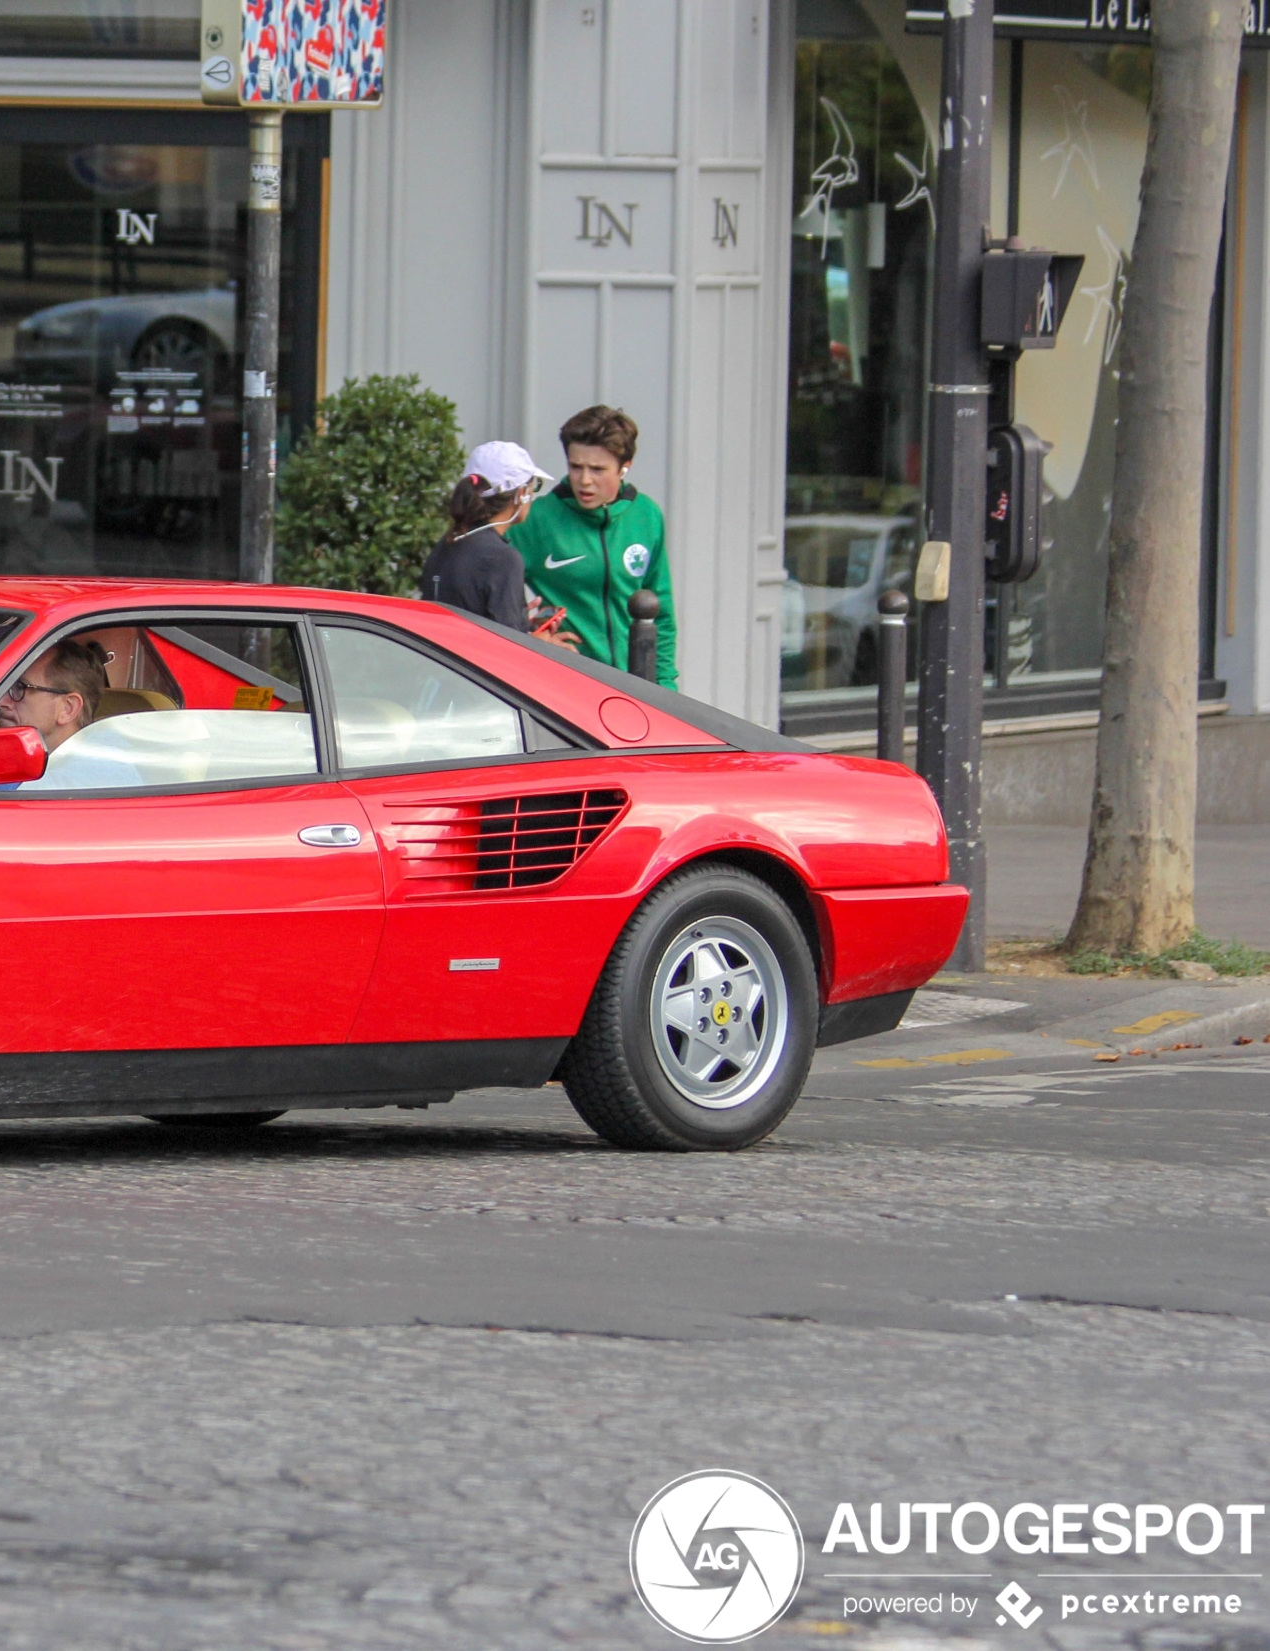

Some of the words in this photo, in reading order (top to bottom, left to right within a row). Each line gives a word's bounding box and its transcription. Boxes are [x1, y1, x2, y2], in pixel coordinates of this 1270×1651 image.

[1090, 0, 1119, 29] Le
[116, 209, 157, 245] LN
[576, 195, 639, 247] LN
[713, 197, 739, 247] LN
